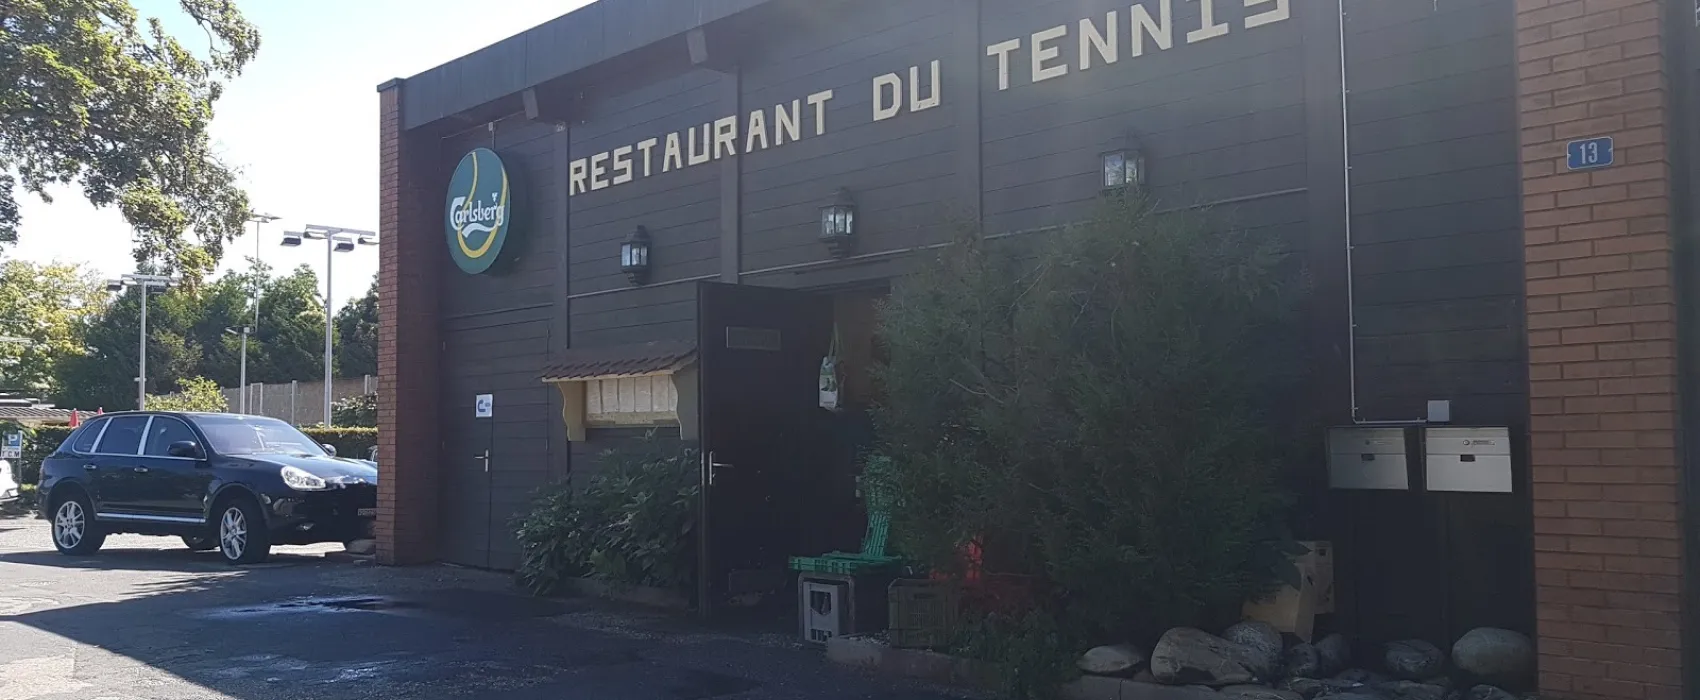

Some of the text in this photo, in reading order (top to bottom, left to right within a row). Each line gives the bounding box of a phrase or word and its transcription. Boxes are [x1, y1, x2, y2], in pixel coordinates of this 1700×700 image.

[569, 89, 833, 196] RESTAURANT
[873, 60, 941, 121] DU
[1580, 142, 1598, 165] 13
[450, 195, 505, 237] Carlsberg
[8, 434, 18, 445] P
